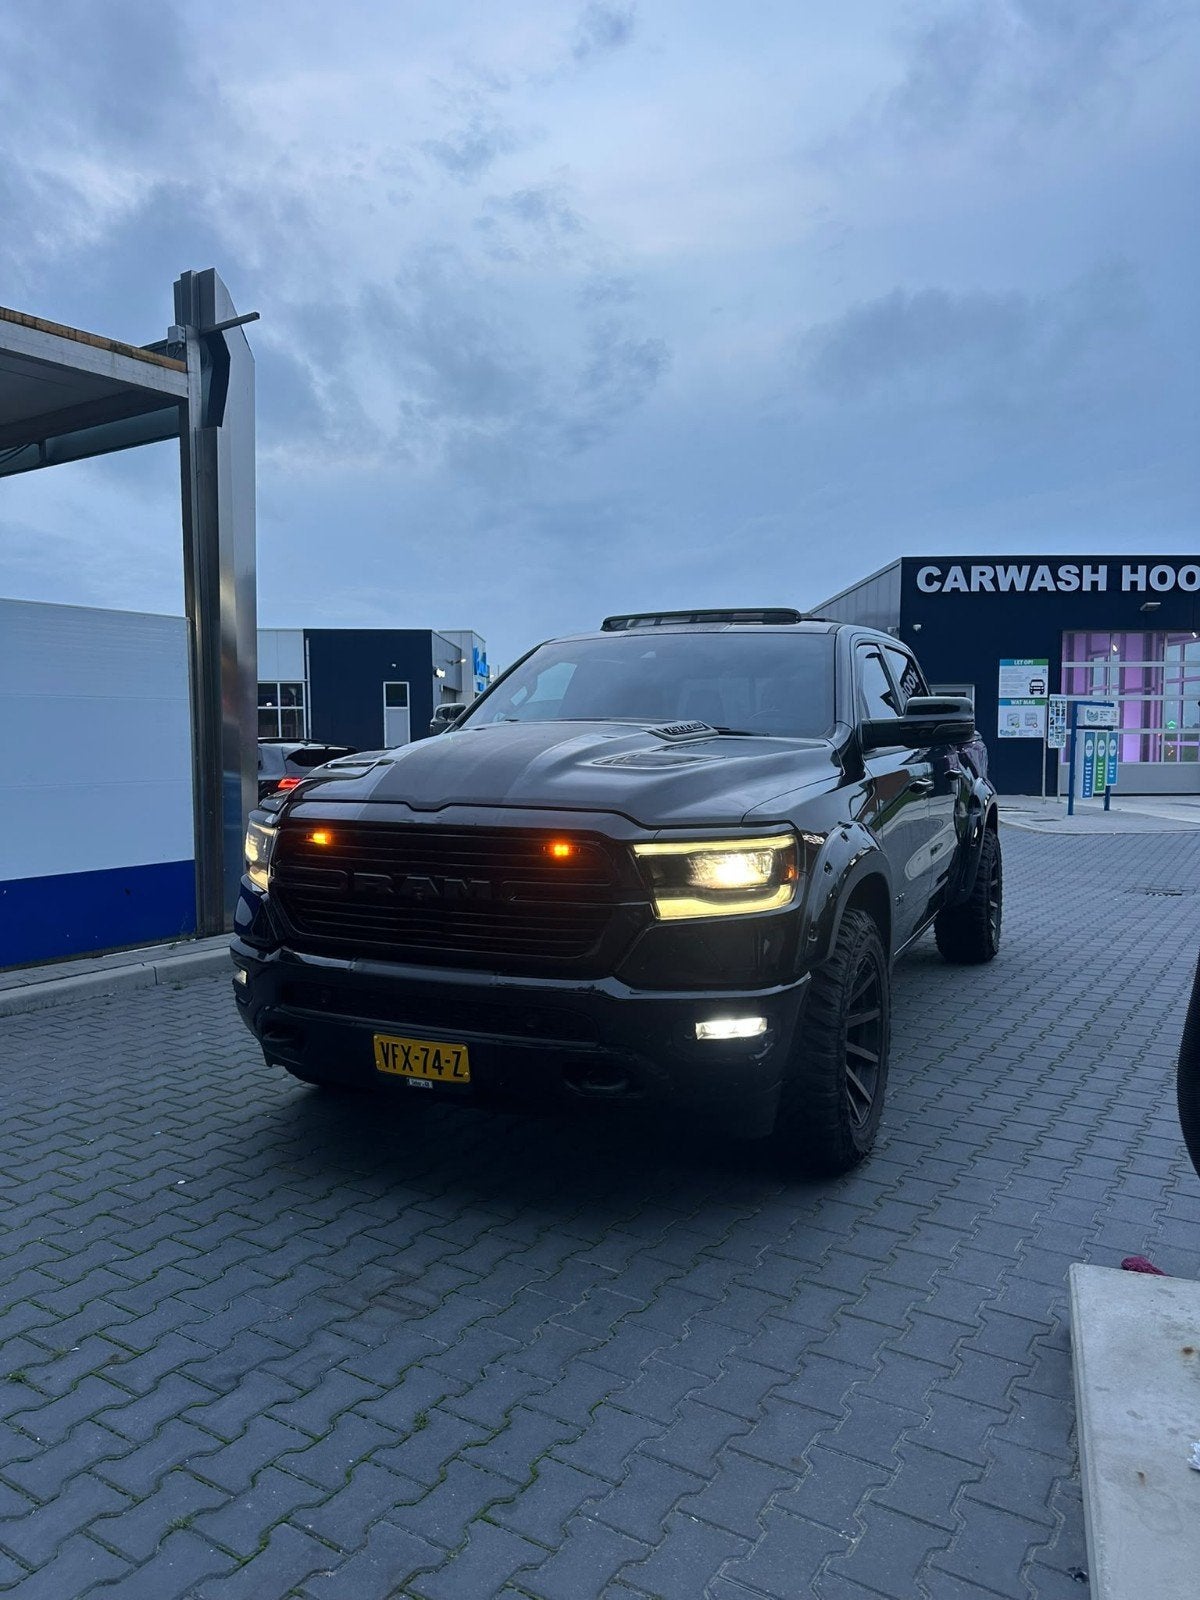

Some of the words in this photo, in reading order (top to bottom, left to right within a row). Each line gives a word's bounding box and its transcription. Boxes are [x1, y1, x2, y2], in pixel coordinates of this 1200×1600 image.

[916, 565, 1108, 593] CARWASH
[1121, 565, 1200, 592] HOO
[353, 871, 491, 902] RAM
[381, 1041, 464, 1077] VFX-74-Z
